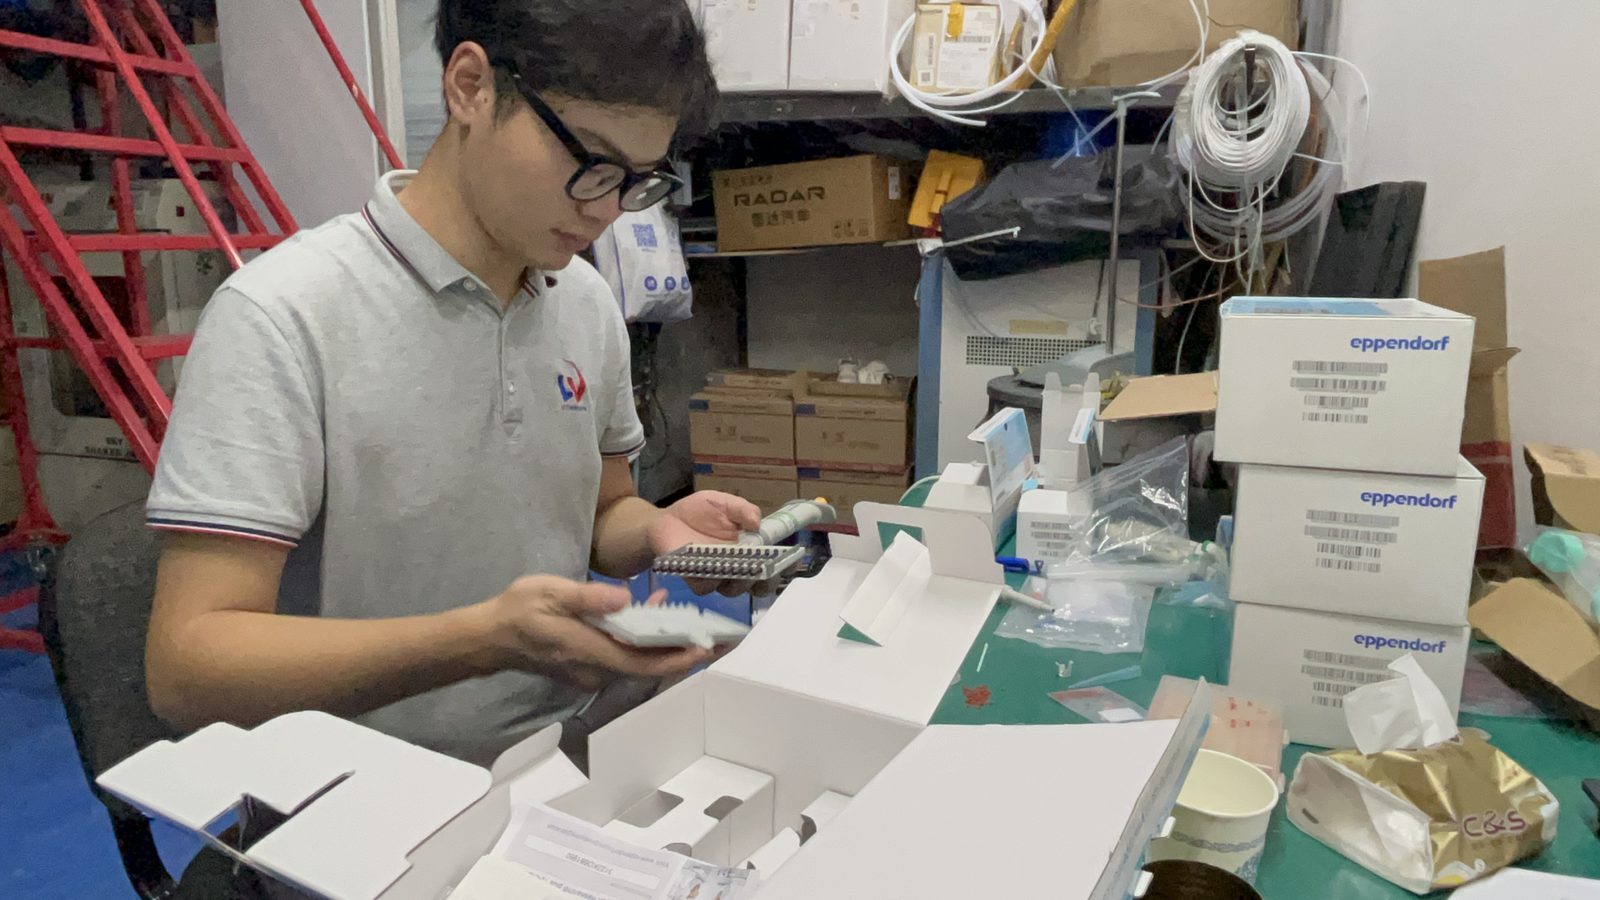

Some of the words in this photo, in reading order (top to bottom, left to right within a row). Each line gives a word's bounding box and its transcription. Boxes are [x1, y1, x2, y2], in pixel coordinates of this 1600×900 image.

[734, 186, 826, 207] RADAR
[1350, 336, 1449, 352] eppendorf
[1361, 491, 1458, 509] eppendorf
[1354, 634, 1447, 653] eppendorf
[1463, 810, 1527, 837] C&S
